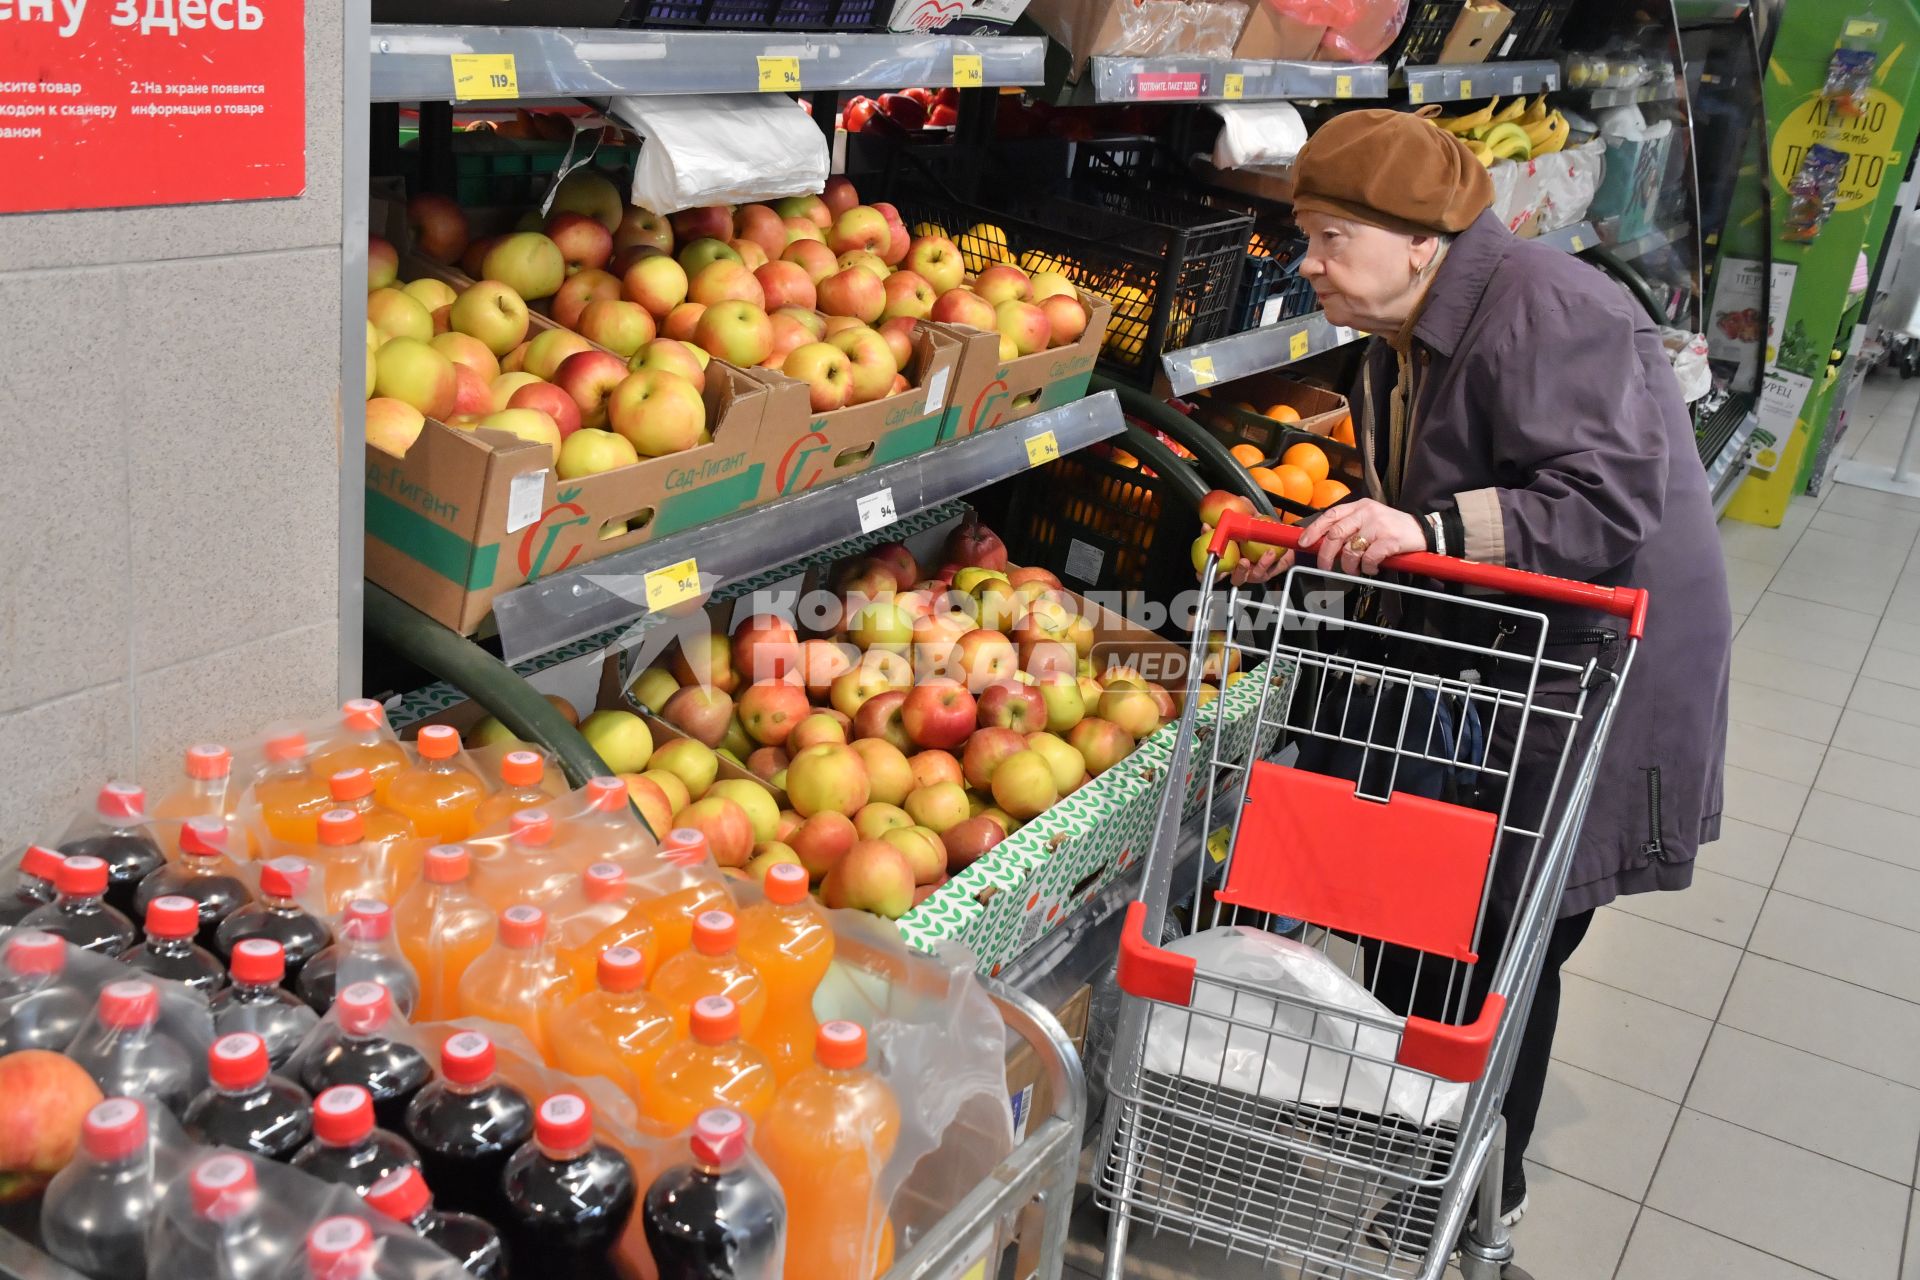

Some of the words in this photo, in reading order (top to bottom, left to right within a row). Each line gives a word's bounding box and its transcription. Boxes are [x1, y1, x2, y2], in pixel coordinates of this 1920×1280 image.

[111, 0, 264, 36] здесь
[489, 74, 508, 87] 119
[784, 71, 796, 82] 94
[39, 83, 82, 96] товар
[145, 82, 162, 94] На
[165, 83, 209, 96] экране
[211, 84, 265, 94] появится
[48, 105, 57, 115] к
[60, 105, 118, 119] сканеру
[131, 103, 211, 118] информация
[214, 106, 222, 114] о
[224, 105, 264, 116] товаре
[665, 452, 747, 490] Сад-Гигант
[880, 505, 892, 518] 94
[678, 578, 693, 592] 94
